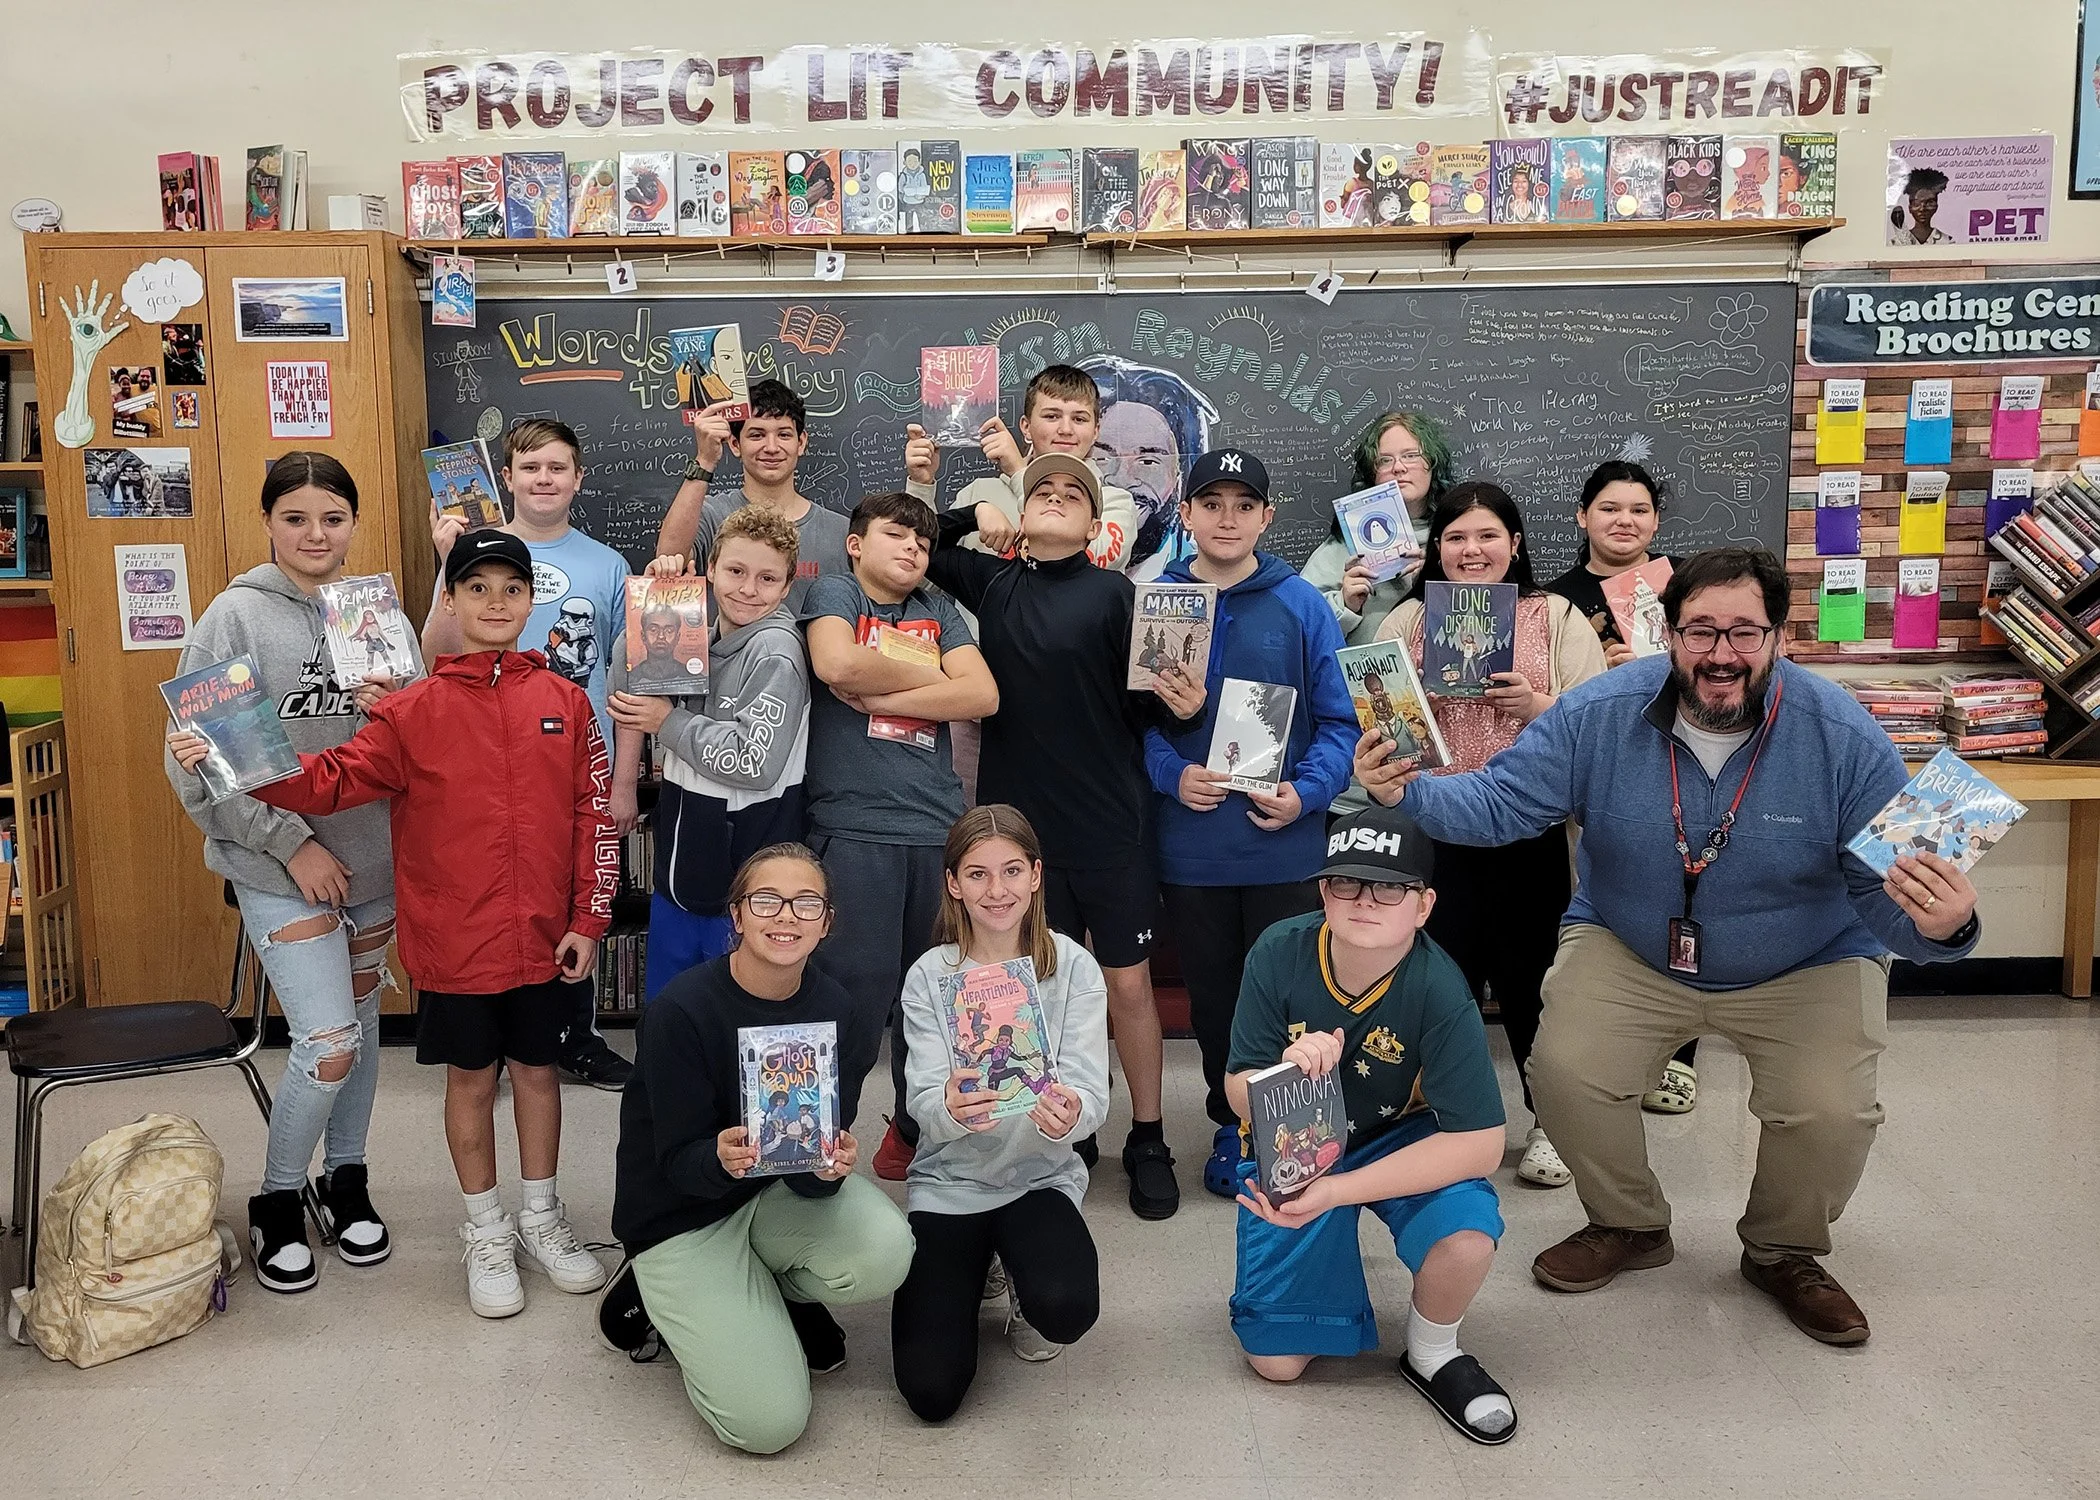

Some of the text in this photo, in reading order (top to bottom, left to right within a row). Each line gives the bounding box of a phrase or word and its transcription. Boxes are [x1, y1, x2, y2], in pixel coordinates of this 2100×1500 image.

[424, 41, 1444, 132] PROJECT LIT COMMUNITY!
[1505, 64, 1883, 124] #JUSTREADIT
[1192, 142, 1245, 158] WINGS
[1496, 139, 1547, 169] YOU SHOULD
[1668, 143, 1720, 159] BLACK KIDS
[1801, 145, 1835, 159] KING
[1918, 148, 1936, 158] are
[1936, 146, 1961, 156] each
[1961, 144, 1997, 156] other's
[929, 159, 955, 178] NEW
[976, 161, 1003, 173] Just
[1257, 159, 1289, 178] LONG
[1818, 164, 1834, 173] AND
[1937, 160, 1949, 168] we
[1964, 157, 1983, 167] each
[1983, 156, 2012, 166] other's
[735, 172, 779, 185] Washington
[973, 174, 1008, 187] Mercy
[1498, 168, 1544, 193] SEE ME
[1955, 167, 2038, 180] we are each other's
[1108, 178, 1128, 189] THE
[1260, 178, 1285, 193] WAY
[1376, 178, 1410, 190] POET X
[1819, 178, 1833, 186] THE
[1953, 181, 2019, 195] magnitude and
[1258, 192, 1290, 209] DOWN
[1570, 188, 1598, 202] FAST
[1787, 191, 1833, 201] DRAGON
[1802, 206, 1833, 216] FLIES
[1968, 208, 2045, 236] PET
[825, 256, 837, 273] 3
[616, 267, 629, 285] 2
[1317, 279, 1332, 295] 4
[146, 292, 182, 314] goes.
[1845, 291, 2015, 327] Reading
[499, 307, 677, 374] Words
[675, 341, 707, 353] YANG
[1875, 324, 2092, 355] Brochures
[270, 367, 327, 379] TODAY I WILL
[1130, 308, 1378, 426] Reynolds!
[272, 379, 328, 390] BE HAPPIER
[628, 361, 846, 418] to by
[864, 376, 909, 397] QUOTES
[945, 374, 972, 390] BLOOD
[272, 390, 328, 401] THAN A BIRD
[1842, 389, 1860, 397] READ
[1918, 390, 1948, 398] TO READ
[285, 401, 316, 412] WITH A
[1482, 390, 1599, 415] The literary
[1828, 397, 1860, 405] HORROR
[1917, 398, 1946, 407] realistic
[274, 412, 329, 423] FRENCH FRY
[1920, 407, 1943, 416] fiction
[126, 422, 146, 431] buddy
[610, 414, 668, 435] feeling
[1470, 418, 1504, 433] World
[435, 456, 478, 472] STEPPING
[1219, 452, 1244, 473] NY
[442, 467, 477, 480] STONES
[1838, 481, 1856, 489] READ
[1909, 490, 1942, 499] fantasy
[1528, 527, 1578, 543] are dead
[125, 552, 147, 561] WHAT
[150, 552, 158, 561] IS
[2040, 561, 2061, 583] ESCAPE
[1827, 576, 1856, 586] mystery
[137, 594, 176, 603] YOU DON'T
[334, 586, 391, 609] PRIMER
[1146, 596, 1205, 610] MAKER
[1451, 588, 1492, 614] LONG
[166, 601, 181, 610] TRY
[1445, 616, 1498, 635] DISTANCE
[1345, 654, 1399, 682] AQUANAUT
[177, 677, 256, 719] WOLF MOON
[179, 677, 219, 704] ARTIE
[279, 691, 353, 718] CADE
[1945, 763, 1960, 775] THE
[1233, 778, 1273, 791] AND THE GLIM
[1916, 764, 2023, 819] BREAKAWAYS
[1771, 813, 1803, 824] Columbia
[1327, 827, 1402, 858] BUSH
[961, 981, 1020, 1005] HEARTLANDS
[762, 1044, 815, 1071] GHOST
[761, 1070, 819, 1092] SQUAD
[1263, 1073, 1337, 1122] NIMONA
